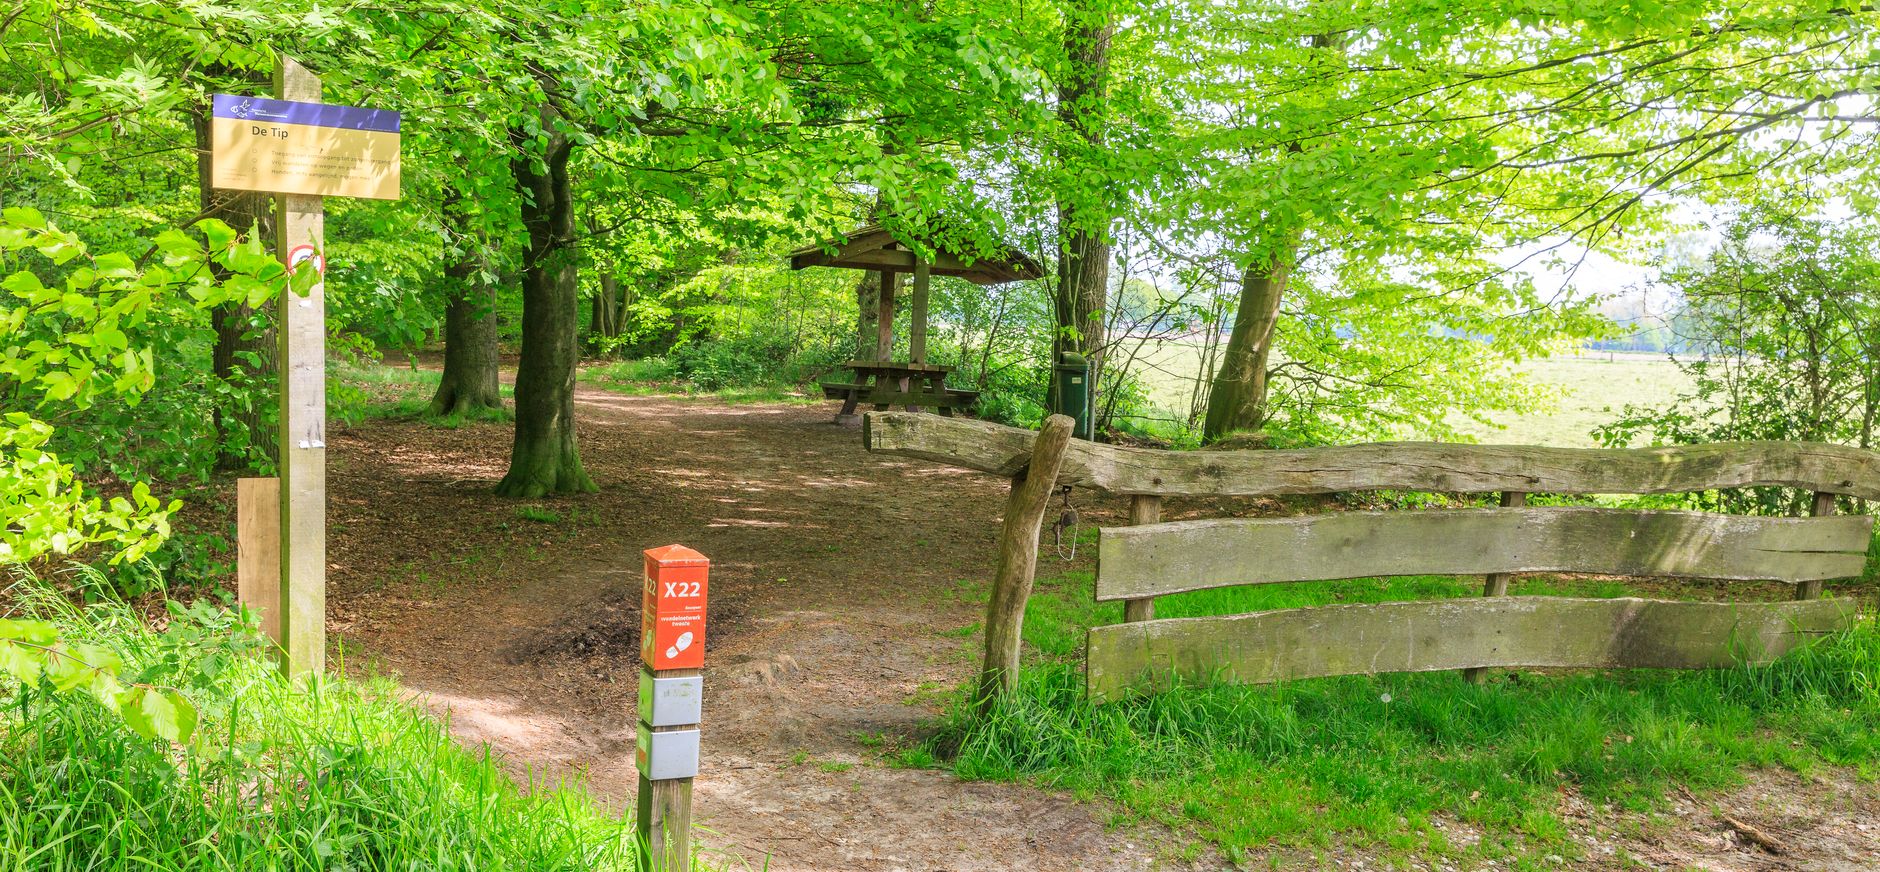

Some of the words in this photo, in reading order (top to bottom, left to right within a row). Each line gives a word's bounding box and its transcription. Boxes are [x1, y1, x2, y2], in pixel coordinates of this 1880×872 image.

[252, 125, 267, 137] De
[271, 127, 288, 140] Tip
[664, 581, 700, 598] X22
